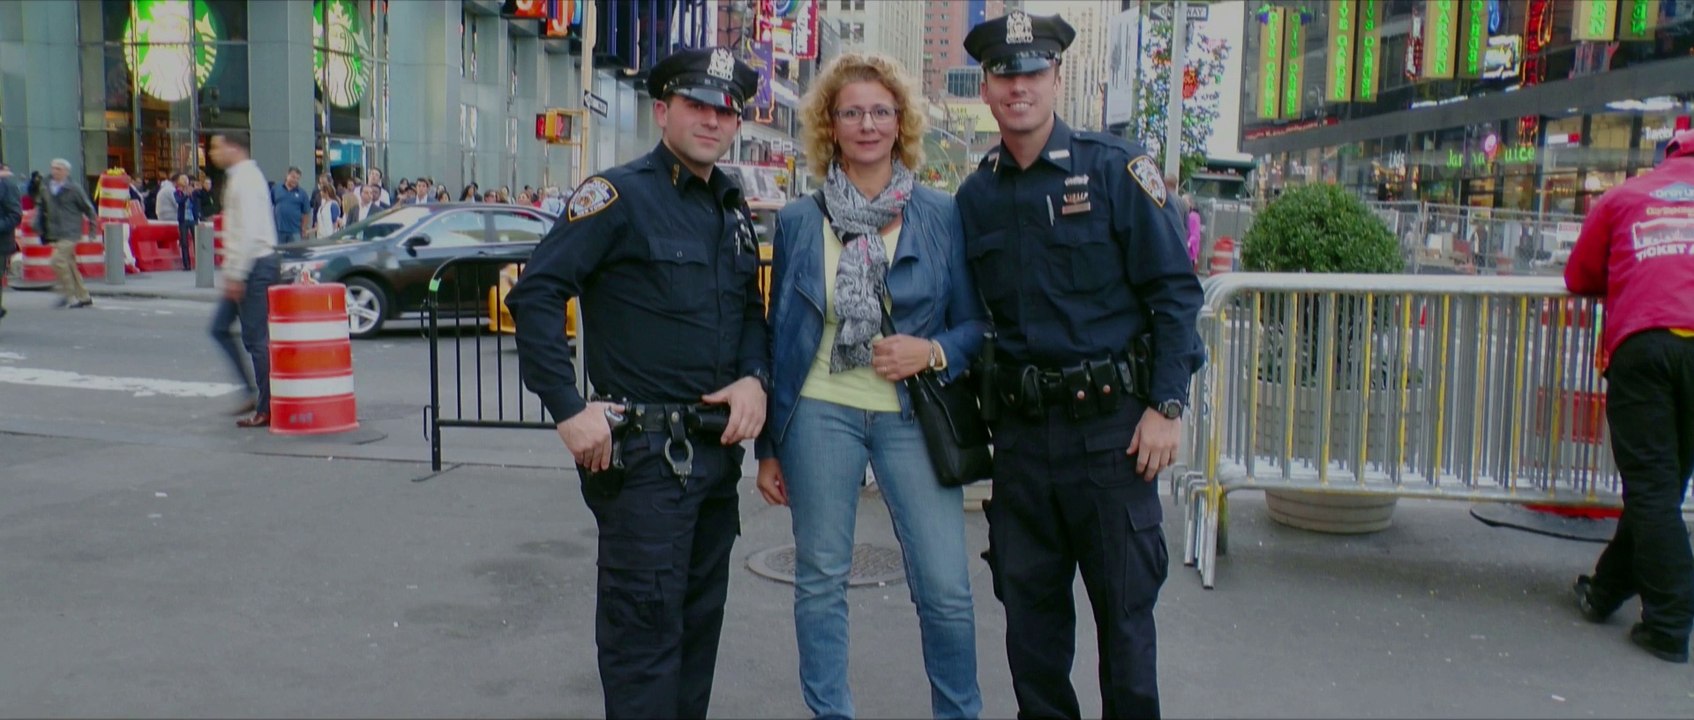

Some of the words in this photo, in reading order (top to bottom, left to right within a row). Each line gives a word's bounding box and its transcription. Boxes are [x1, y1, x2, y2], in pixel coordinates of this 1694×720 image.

[1338, 0, 1349, 31] IVE
[1334, 34, 1349, 99] GARDEN
[1446, 149, 1486, 168] Jaa
[1504, 144, 1536, 162] uice
[1635, 243, 1687, 262] TICKET
